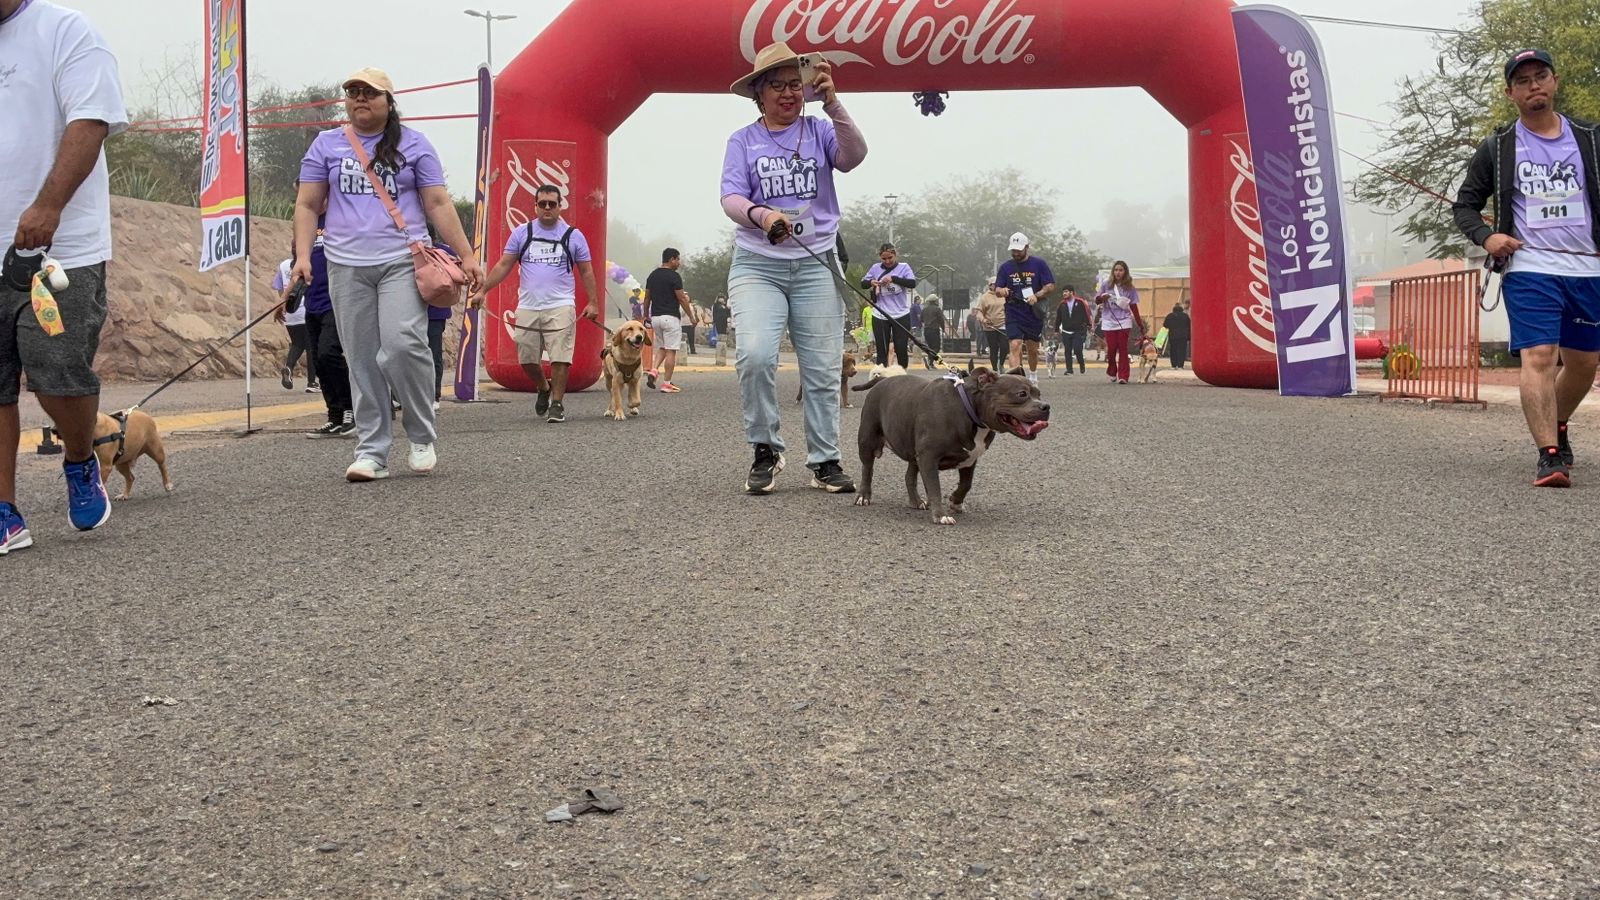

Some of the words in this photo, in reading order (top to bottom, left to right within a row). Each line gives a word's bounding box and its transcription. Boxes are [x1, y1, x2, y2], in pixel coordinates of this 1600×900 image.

[757, 156, 790, 178] CAN
[1287, 50, 1332, 270] Noticieristas
[1518, 162, 1550, 182] CAN
[761, 171, 816, 199] RRERA
[1541, 205, 1567, 218] 141
[1281, 224, 1300, 274] Los
